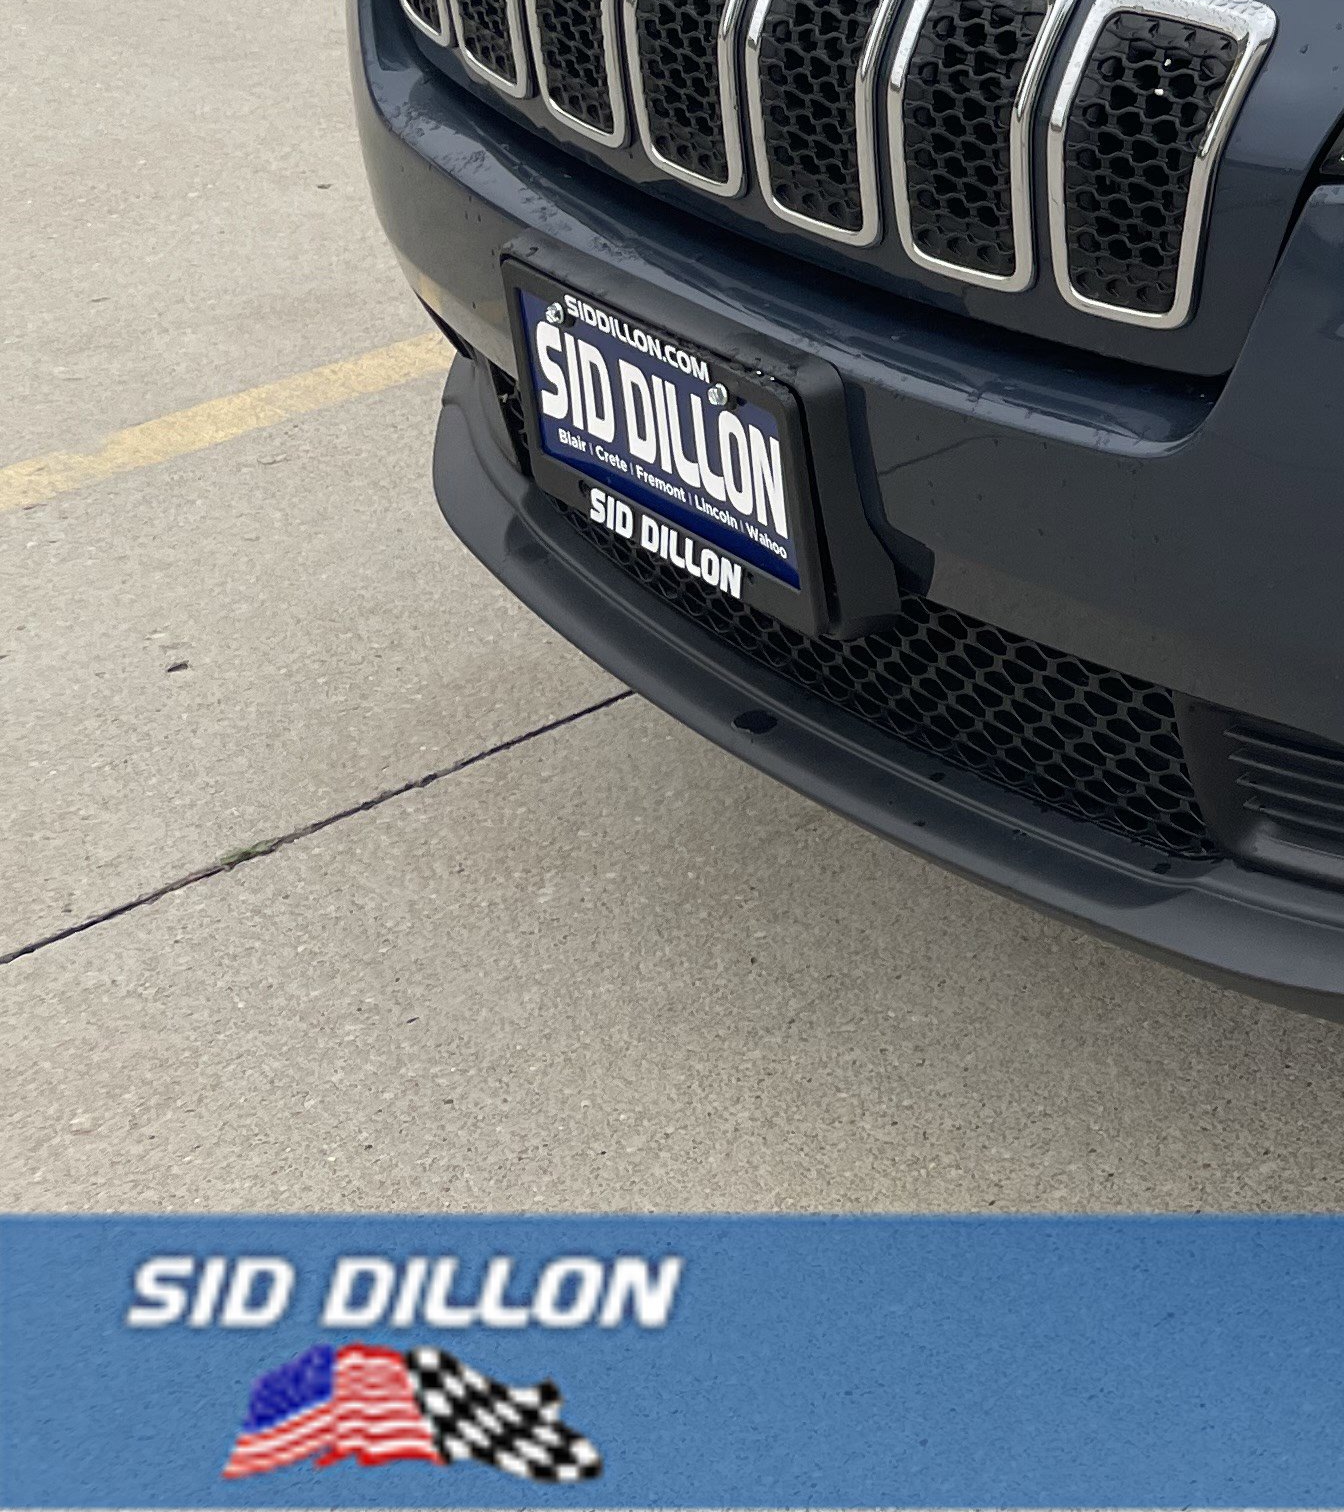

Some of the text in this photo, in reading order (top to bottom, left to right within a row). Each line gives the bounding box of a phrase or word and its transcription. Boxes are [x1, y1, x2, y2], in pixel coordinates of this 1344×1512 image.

[564, 294, 710, 383] SIDDILLON.COM
[536, 321, 788, 539] SID DILLON
[558, 428, 788, 559] Blair Crete Fremont Lincoln Wahoo
[590, 488, 742, 599] SID DILLON
